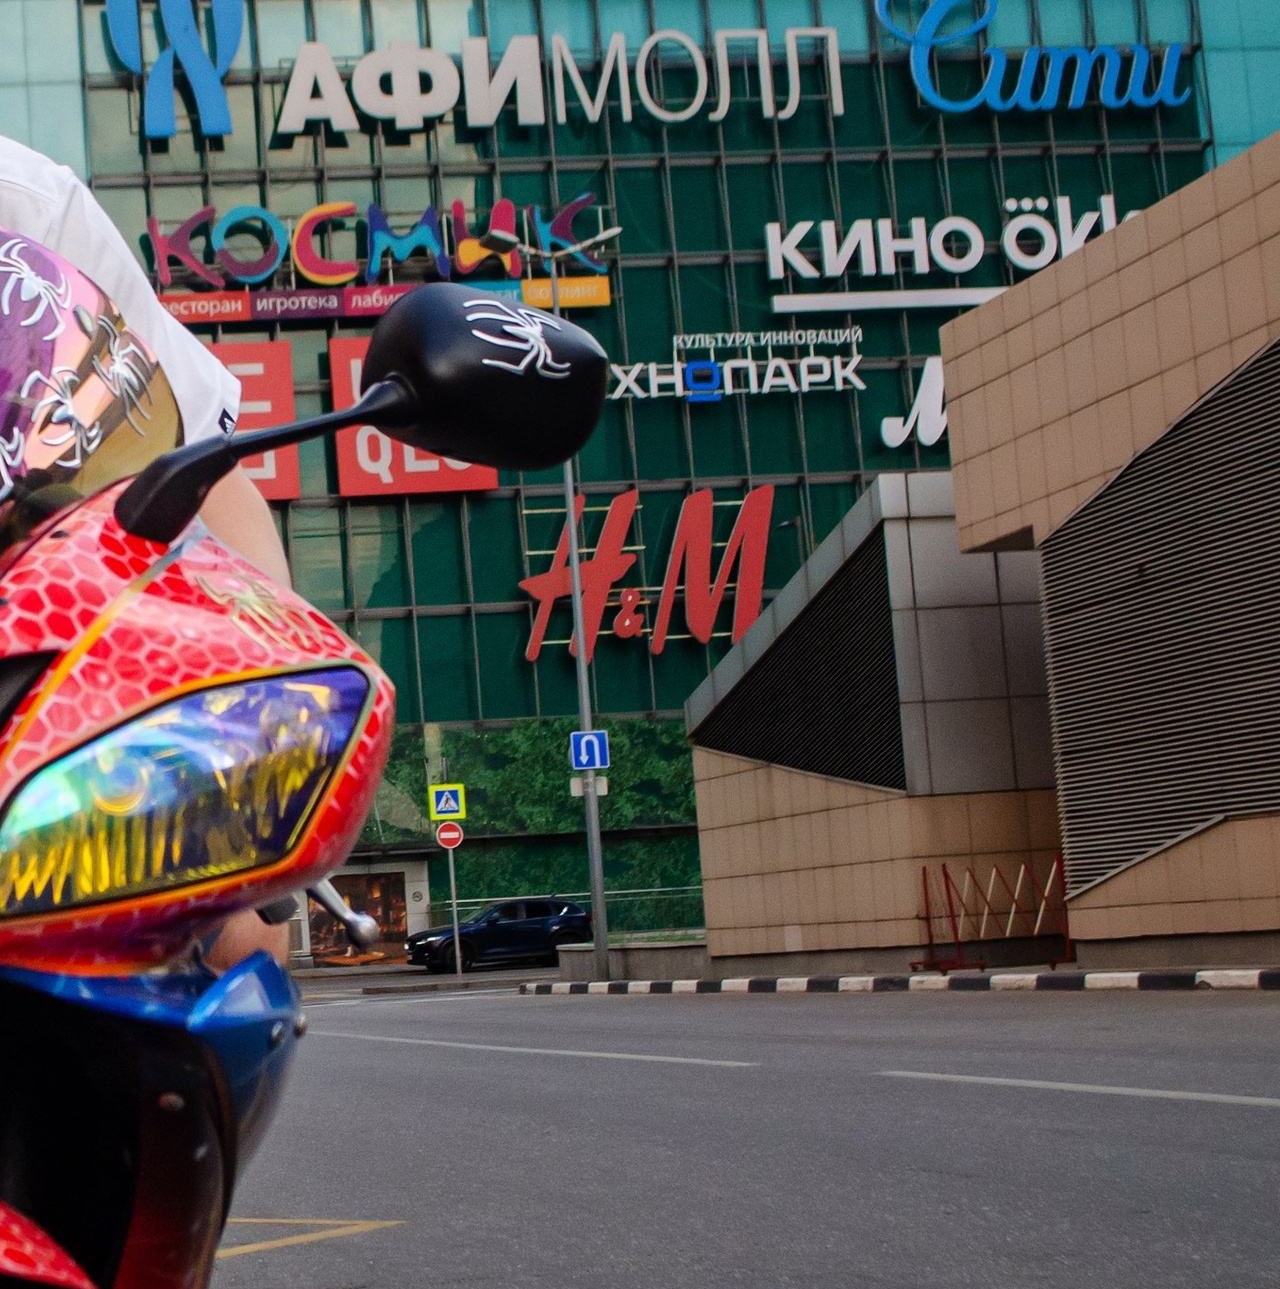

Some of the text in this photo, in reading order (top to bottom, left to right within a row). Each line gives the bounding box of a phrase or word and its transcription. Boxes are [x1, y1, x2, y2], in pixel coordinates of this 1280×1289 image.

[146, 191, 609, 287] КОСМИК
[765, 216, 986, 280] КИНО
[256, 293, 339, 317] игротека
[527, 282, 599, 301] болинг
[673, 325, 864, 349] КУЛЬТУРА ИННОВАЦИЙ
[355, 425, 473, 484] QL
[518, 483, 776, 665] H&M
